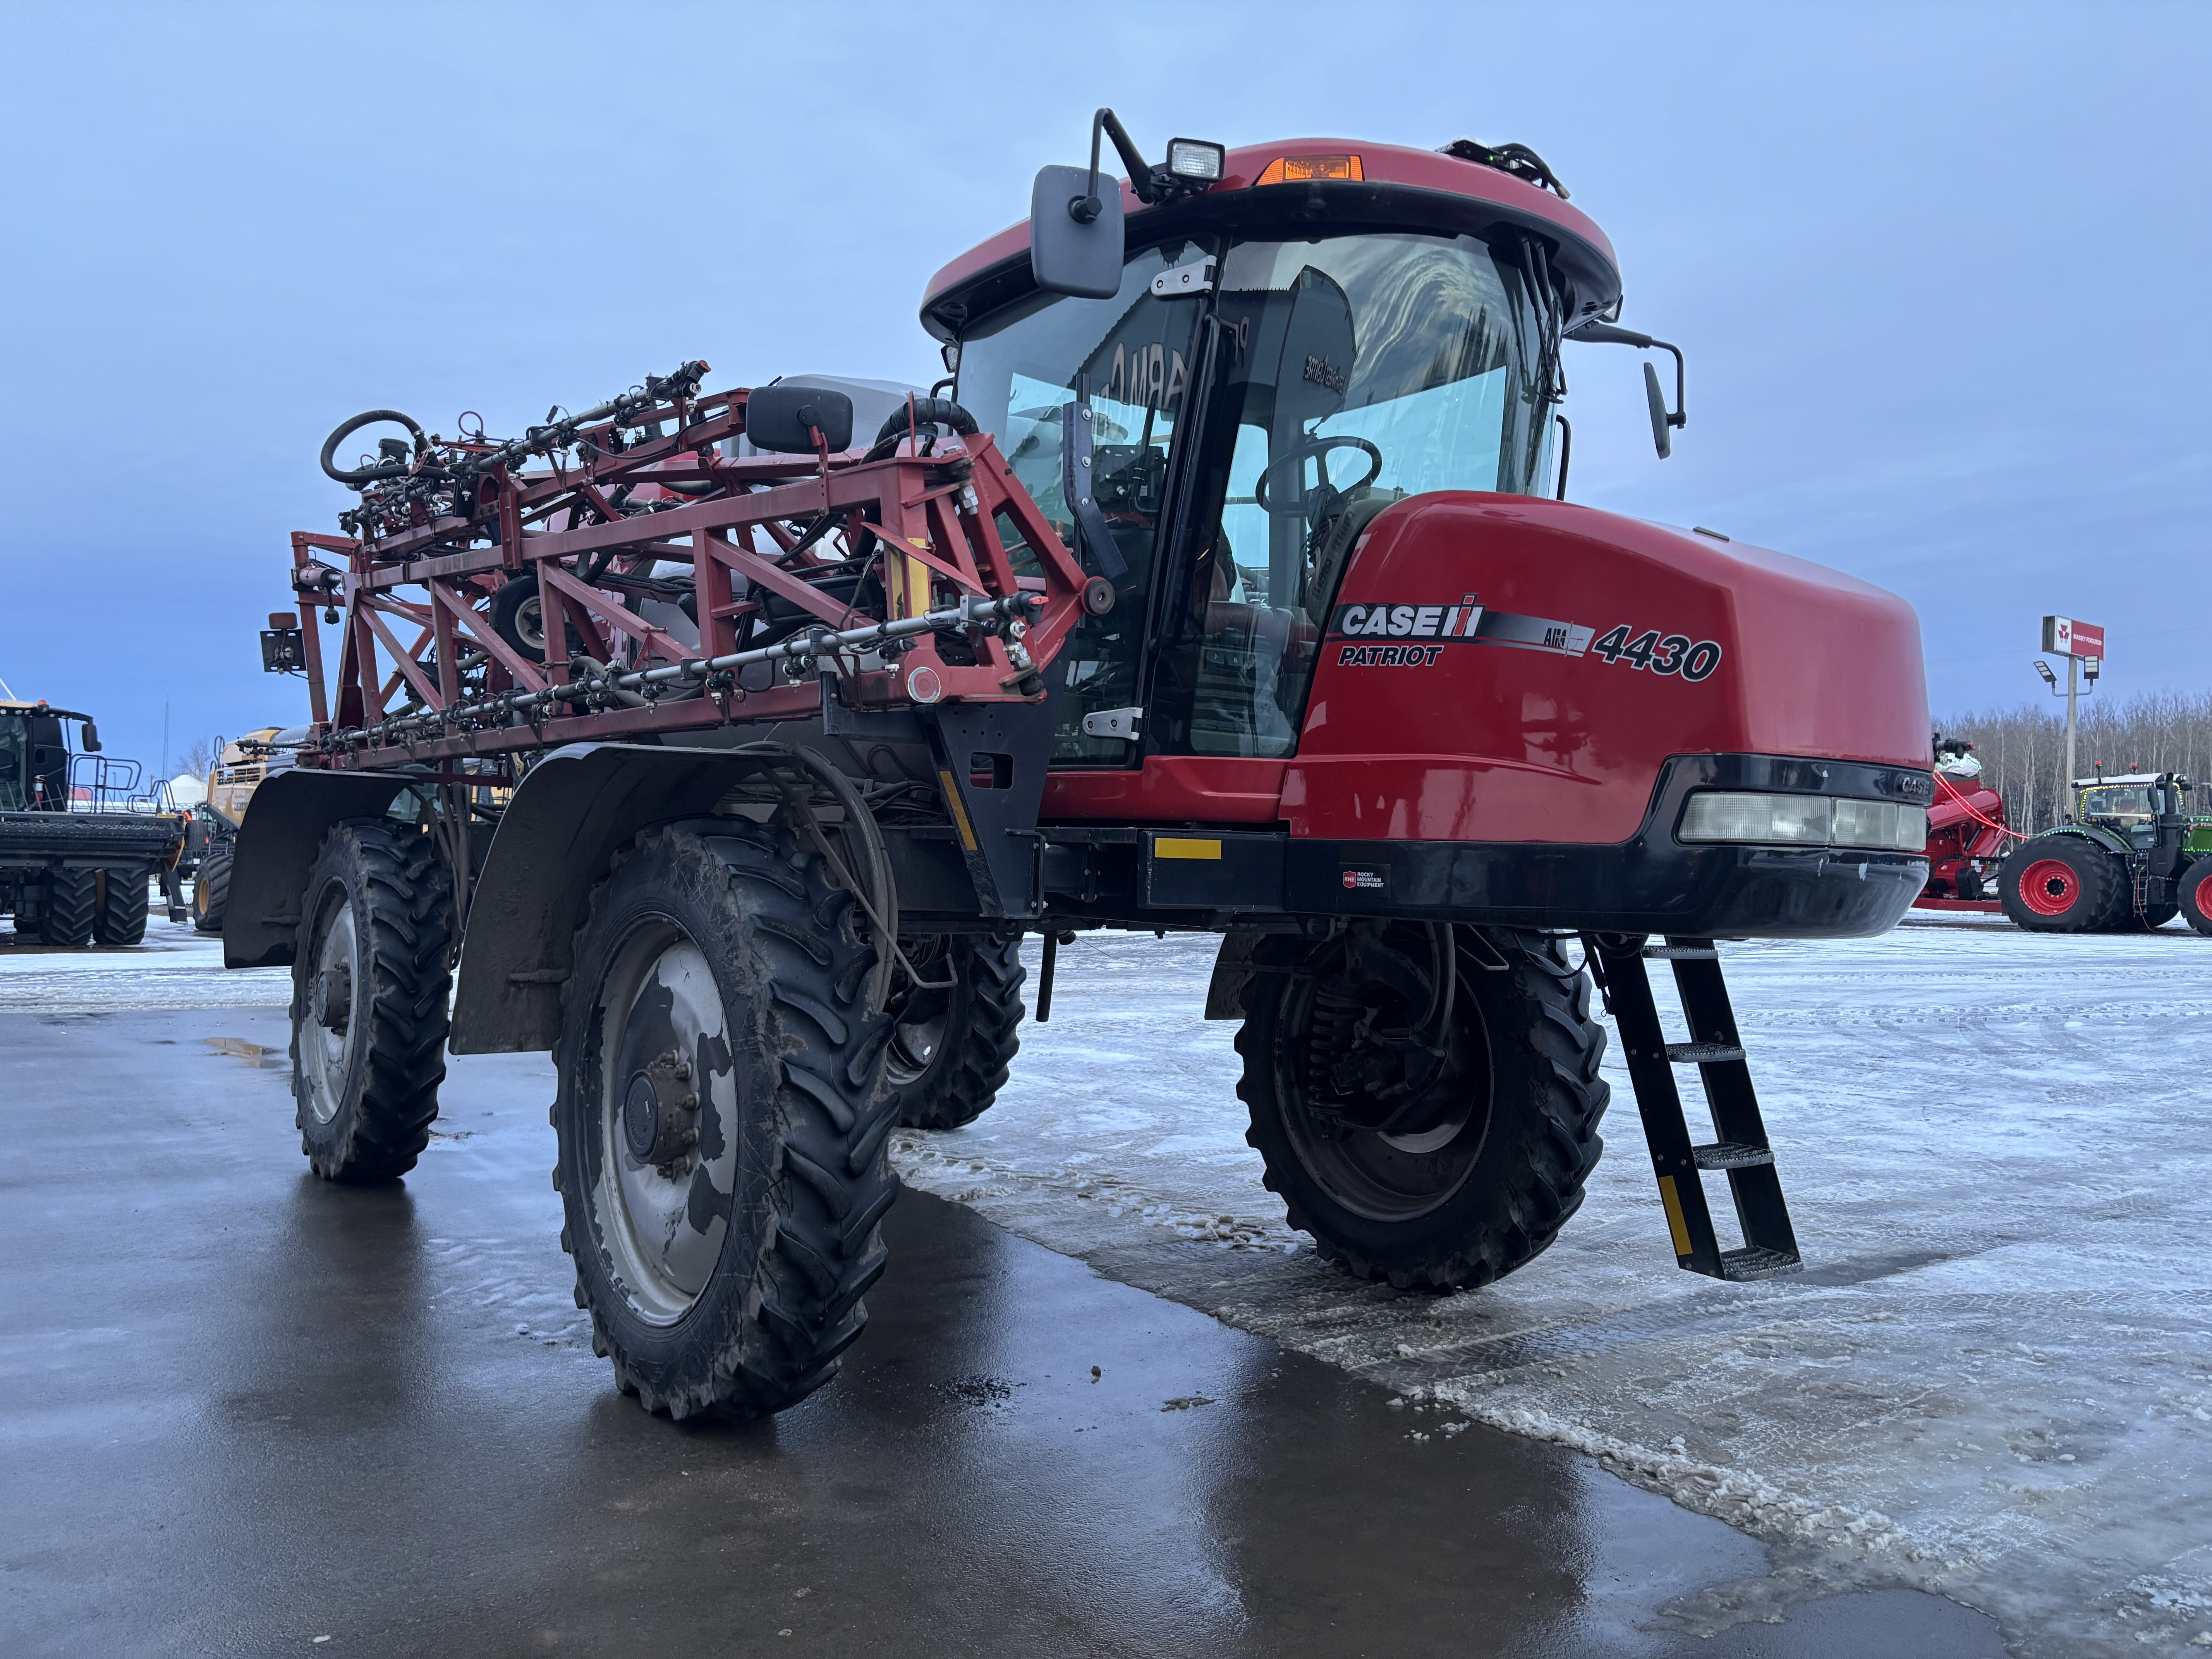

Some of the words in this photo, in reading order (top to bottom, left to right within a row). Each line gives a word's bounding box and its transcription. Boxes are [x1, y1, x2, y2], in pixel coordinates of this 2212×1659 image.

[1342, 606, 1443, 635] CASE
[2073, 634, 2086, 642] MASSEY
[2086, 637, 2102, 646] FERGUSON
[1337, 645, 1444, 666] PATRIOT
[1591, 624, 1722, 682] 4430
[1902, 776, 1930, 794] CASE
